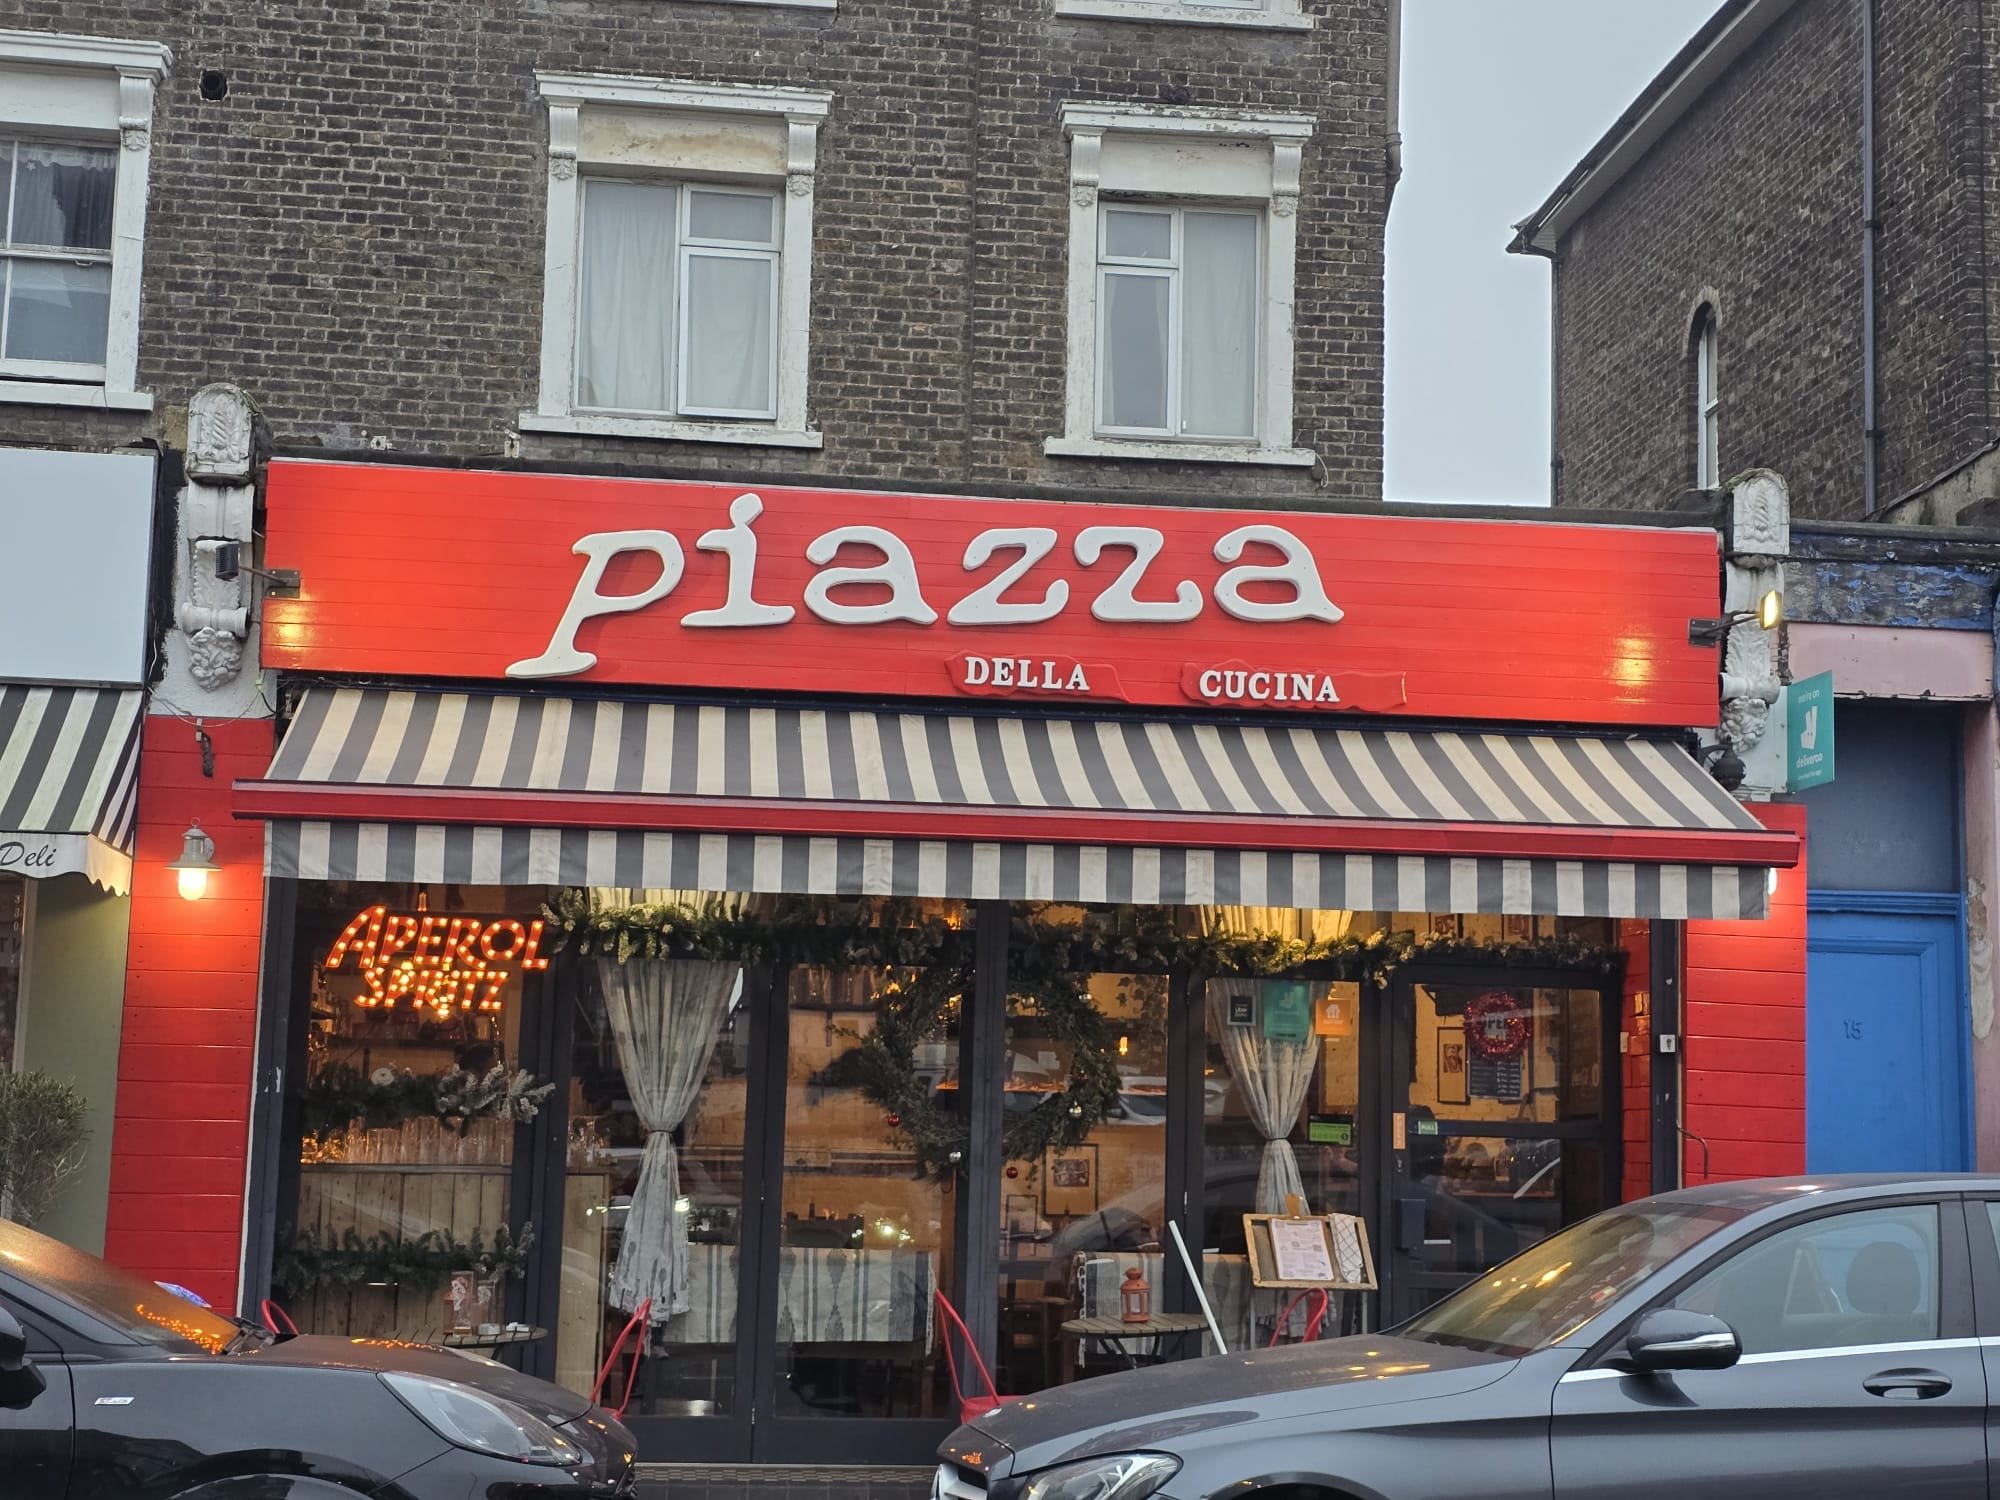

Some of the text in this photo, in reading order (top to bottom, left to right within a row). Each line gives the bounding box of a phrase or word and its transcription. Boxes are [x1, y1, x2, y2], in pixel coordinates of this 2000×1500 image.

[505, 492, 1344, 679] piazza
[964, 655, 1341, 703] DELLA CUCINA
[0, 841, 57, 867] Deli
[325, 905, 549, 969] APEROL
[354, 966, 508, 1010] SPRITZ
[1843, 1020, 1862, 1040] 15
